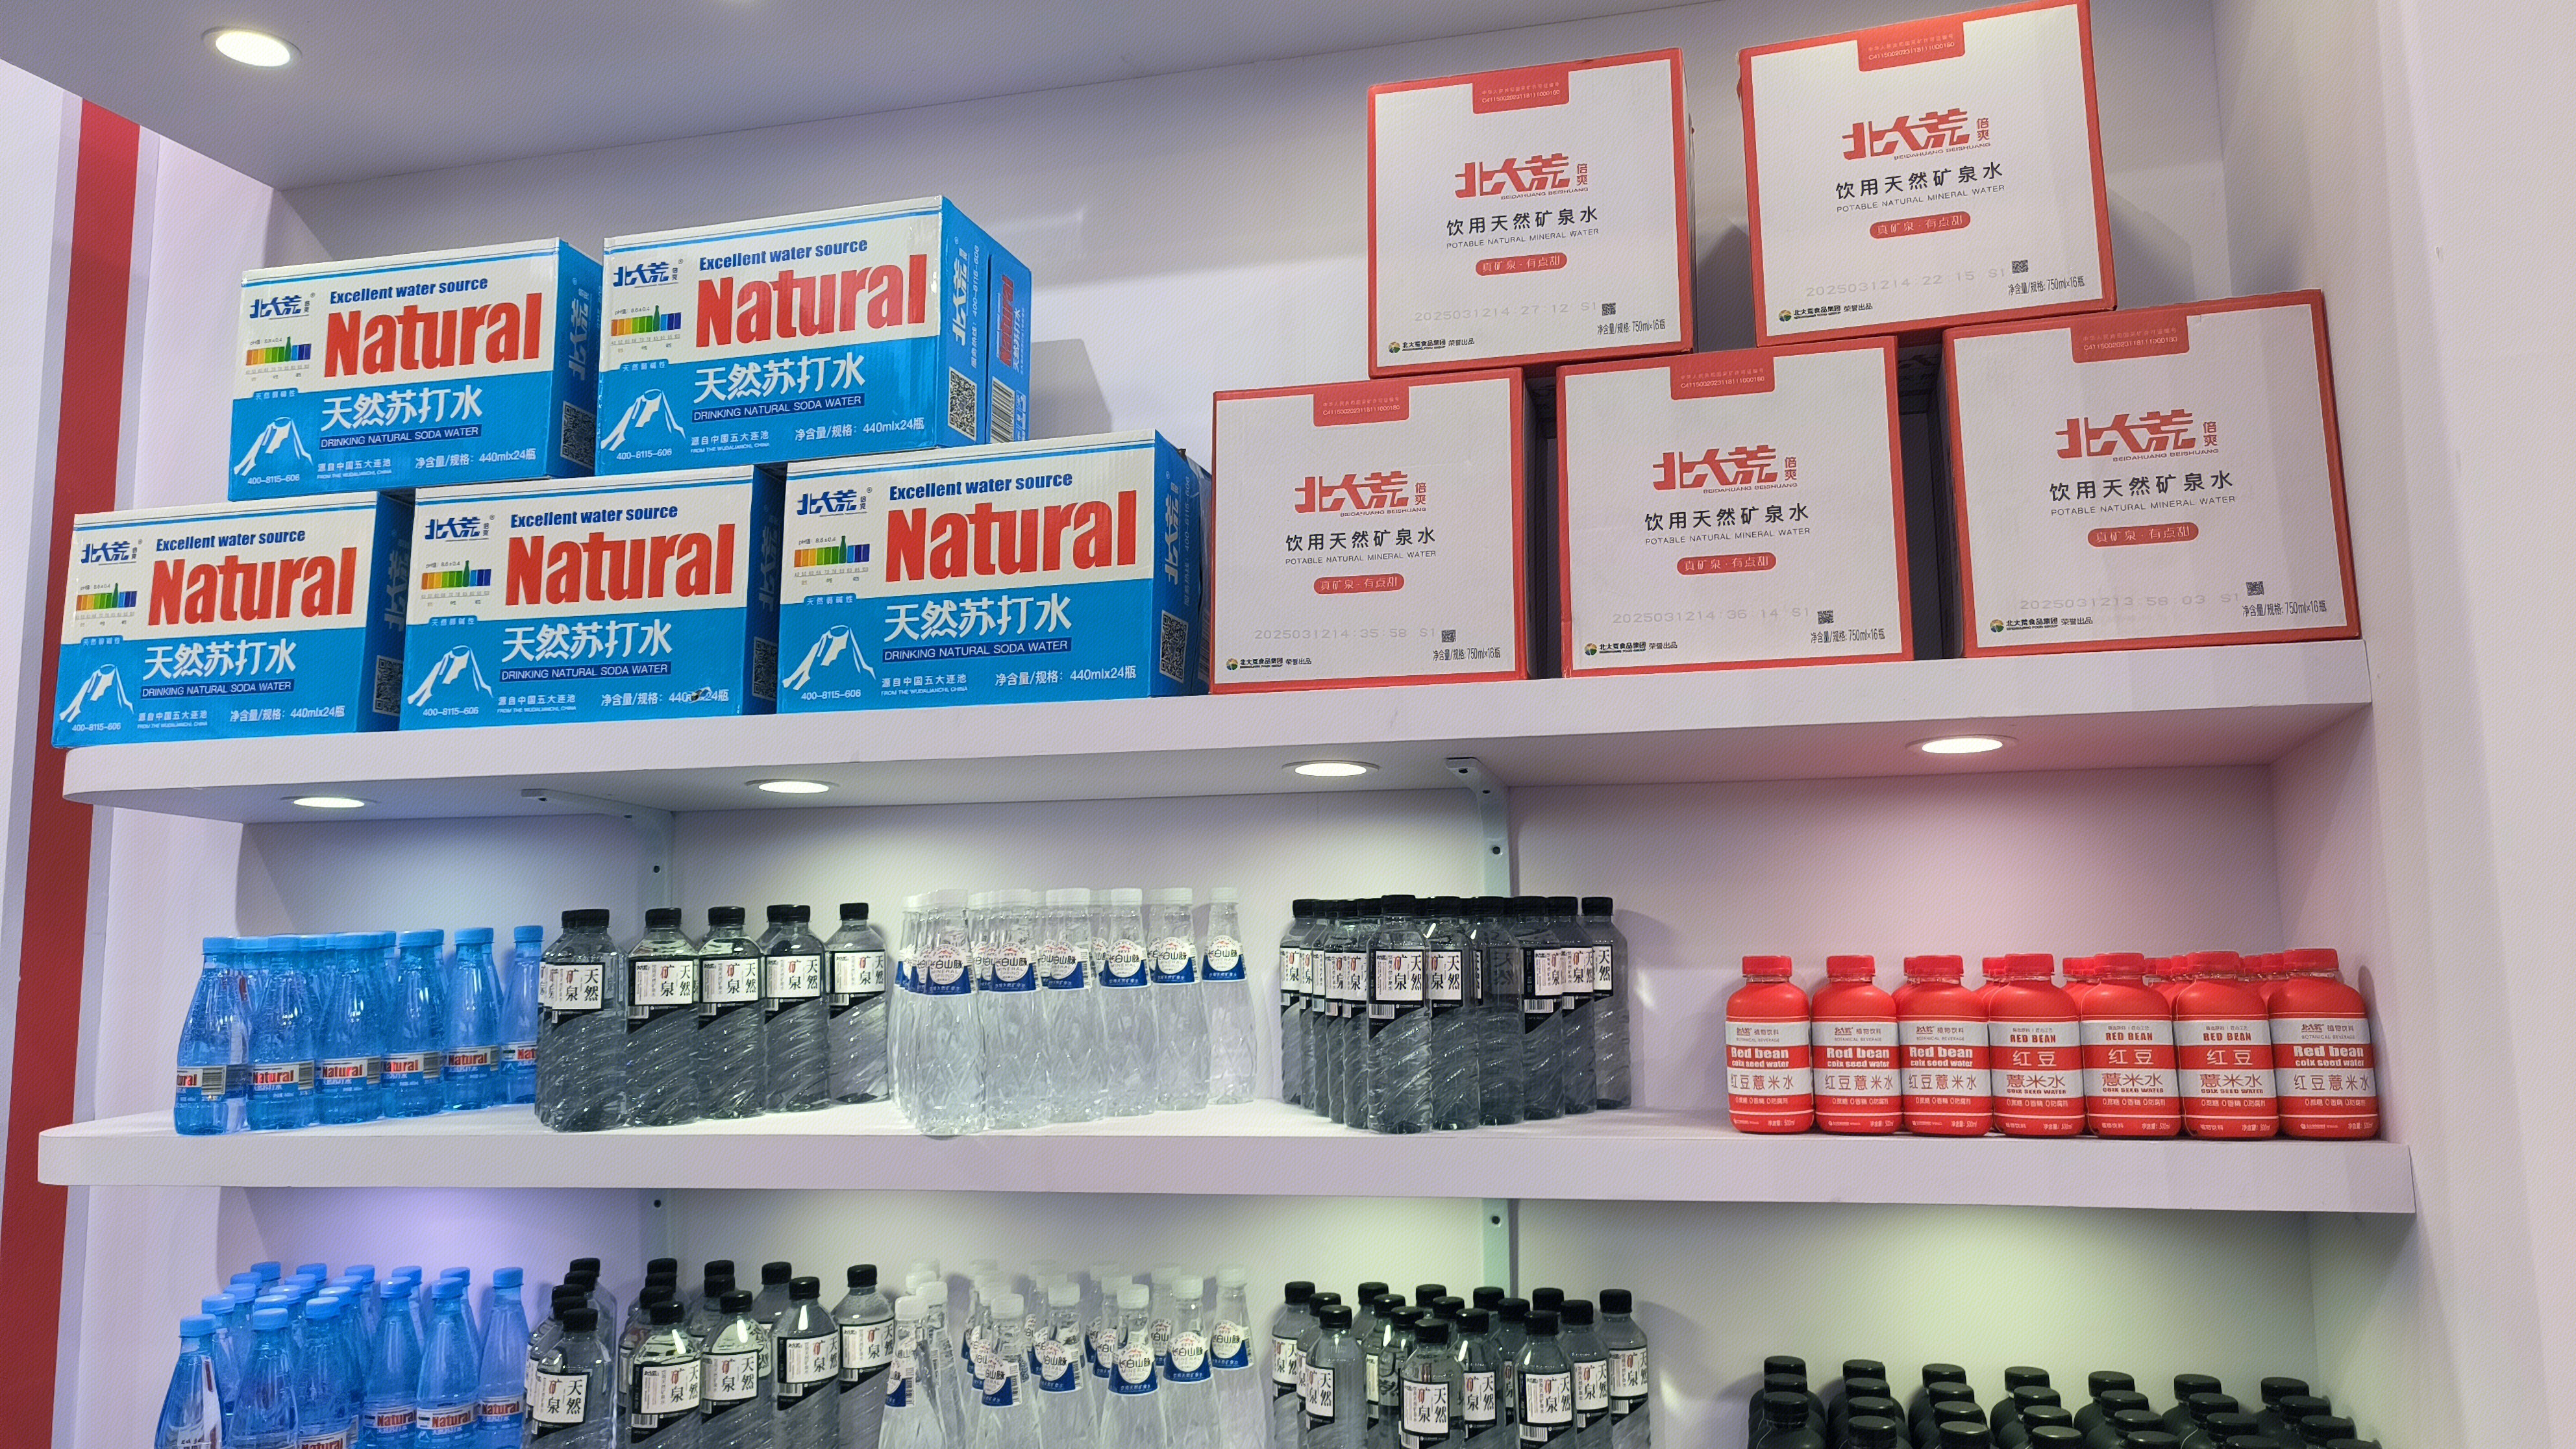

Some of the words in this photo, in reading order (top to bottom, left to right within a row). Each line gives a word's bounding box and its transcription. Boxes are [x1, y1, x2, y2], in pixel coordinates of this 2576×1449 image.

[1842, 107, 1970, 160] 北大荒
[1455, 153, 1570, 197] 北大荒
[1835, 162, 2002, 199] 饮用天然矿泉水
[1837, 201, 1877, 212] POTABLE
[1881, 196, 1923, 206] NATURAL
[1927, 190, 1968, 201] MINERAL
[1972, 184, 2004, 194] WATER
[1446, 206, 1598, 236] 饮用天然矿泉水
[1446, 239, 1483, 248] POTABLE
[1529, 232, 1566, 241] MINERAL
[1570, 228, 1599, 236] WATER
[699, 251, 766, 271] Excellent
[769, 246, 811, 262] water
[815, 240, 867, 256] source
[329, 286, 392, 304] Excellent
[395, 283, 435, 297] water
[438, 277, 487, 293] source
[695, 253, 927, 347] Natural
[324, 291, 543, 377] Natural
[693, 351, 865, 403] 天然苏打水
[321, 384, 482, 430] 天然苏打水
[694, 408, 741, 420] DRINKING
[744, 403, 790, 415] NATURAL
[793, 399, 822, 410] SODA
[824, 395, 861, 407] WATER
[321, 436, 365, 447] DRINKING
[368, 432, 411, 443] NATURAL
[414, 429, 441, 440] SODA
[444, 427, 478, 437] WATER
[2055, 408, 2196, 458] 北大荒
[1652, 444, 1777, 490] 北大荒
[889, 482, 961, 501] Excellent
[965, 478, 1011, 494] water
[1015, 473, 1072, 489] source
[1294, 470, 1409, 512] 北大荒
[2050, 470, 2233, 501] 饮用天然矿泉水
[510, 511, 577, 528] Excellent
[580, 509, 623, 523] water
[626, 506, 677, 520] source
[1644, 503, 1808, 530] 饮用天然矿泉水
[2051, 506, 2096, 515] POTABLE
[2100, 503, 2146, 512] NATURAL
[2150, 499, 2195, 508] MINERAL
[2199, 495, 2235, 504] WATER
[155, 536, 215, 551] Excellent
[218, 533, 256, 547] water
[258, 530, 305, 543] source
[886, 490, 1137, 582] Natural
[1286, 526, 1435, 551] 饮用天然矿泉水
[1645, 536, 1685, 544] POTABLE
[1734, 530, 1774, 539] MINERAL
[505, 523, 736, 606] Natural
[1285, 556, 1322, 565] POTABLE
[147, 546, 357, 626] Natural
[884, 592, 1071, 641] 天然苏打水
[501, 618, 672, 662] 天然苏打水
[884, 648, 935, 660] DRINKING
[939, 645, 989, 656] NATURAL
[993, 643, 1024, 653] SODA
[1028, 639, 1067, 651] WATER
[142, 638, 296, 680] 天然苏打水
[501, 669, 548, 680] DRINKING
[551, 667, 597, 677] NATURAL
[601, 665, 629, 675] SODA
[632, 663, 667, 673] WATER
[142, 686, 184, 697] DRINKING
[186, 684, 227, 694] NATURAL
[230, 683, 256, 692] SODA
[258, 681, 291, 691] WATER
[584, 968, 599, 1001] 天然
[745, 961, 756, 993] 天然
[807, 959, 818, 989] 天然
[1411, 954, 1422, 990] 天然
[1447, 954, 1459, 990] 天然
[1909, 1046, 1934, 1058] Red
[1938, 1047, 1973, 1058] bean
[2011, 1034, 2029, 1043] RED
[2032, 1035, 2056, 1043] BEAN
[2293, 1045, 2325, 1057] Red
[449, 1053, 487, 1067] Natural
[1731, 1047, 1752, 1058] Red
[1755, 1048, 1789, 1059] bean
[2012, 1050, 2057, 1067] 红豆
[2109, 1048, 2154, 1065] 红豆
[253, 1070, 294, 1084] Natural
[323, 1064, 363, 1078] Natural
[1731, 1074, 1794, 1090] 红豆薏米水
[1825, 1074, 1893, 1090] 红豆薏米水
[1909, 1074, 1977, 1090] 红豆薏米水
[2007, 1074, 2066, 1088] 薏米水
[2101, 1072, 2162, 1087] 薏米水
[2294, 1074, 2369, 1091] 红豆薏米水
[741, 1356, 754, 1391] 天然
[566, 1379, 583, 1415] 天然
[1434, 1387, 1446, 1424] 天然
[1560, 1375, 1570, 1412] 天然
[432, 1411, 471, 1428] Natural
